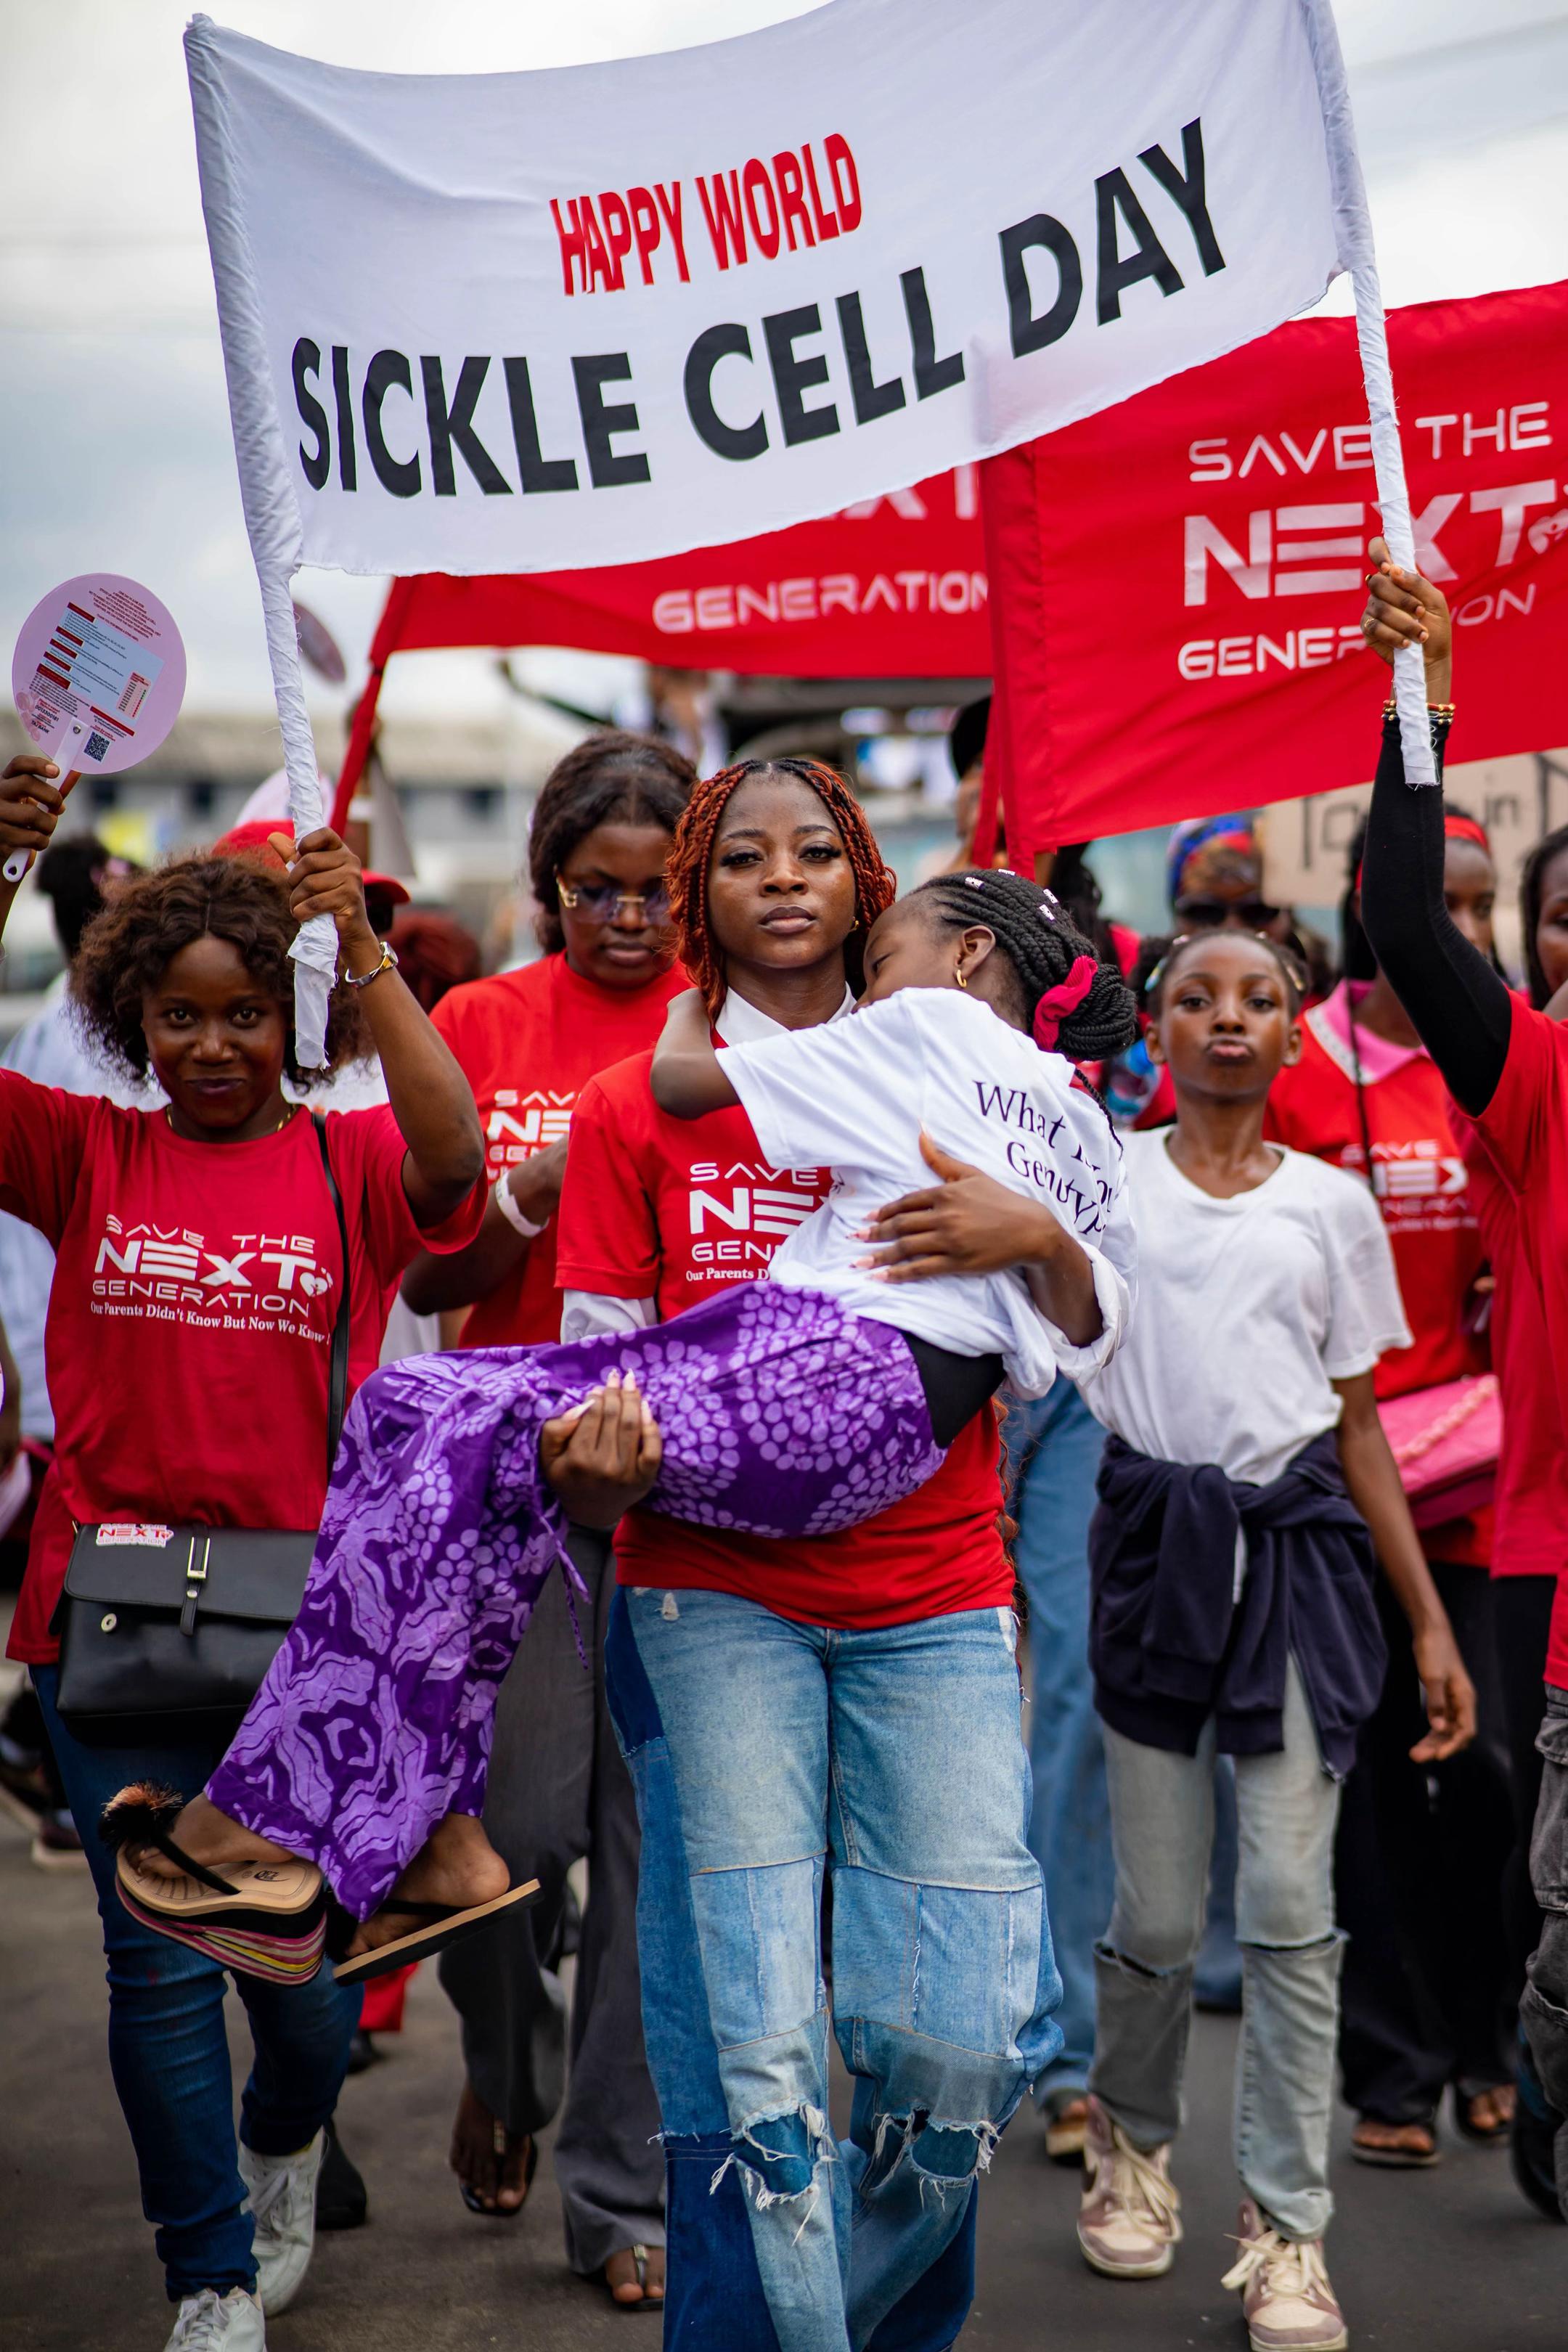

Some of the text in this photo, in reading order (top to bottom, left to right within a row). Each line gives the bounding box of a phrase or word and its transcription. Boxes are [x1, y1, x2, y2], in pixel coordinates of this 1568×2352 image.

[550, 133, 862, 295] HAPPY WORLD
[292, 116, 1226, 498] SICKLE CELL DAY
[1189, 401, 1552, 482] SAVE THE
[494, 1090, 581, 1108] SAV
[972, 1079, 1066, 1148] What
[690, 1162, 820, 1186] SAVE
[689, 1187, 829, 1236] NE
[106, 1213, 316, 1254] SAVE THE
[692, 1240, 784, 1262] GEN
[94, 1236, 317, 1291] NEXT
[686, 1270, 704, 1283] Our
[706, 1267, 754, 1280] Parents
[91, 1300, 103, 1315] Our
[105, 1302, 143, 1317] Parents
[146, 1304, 184, 1322] Didn't
[187, 1310, 221, 1328] Know
[223, 1314, 246, 1330] But
[248, 1315, 275, 1331] Now
[277, 1318, 295, 1334] We
[92, 1279, 310, 1318] GENERATION
[99, 1528, 166, 1539] NEXT
